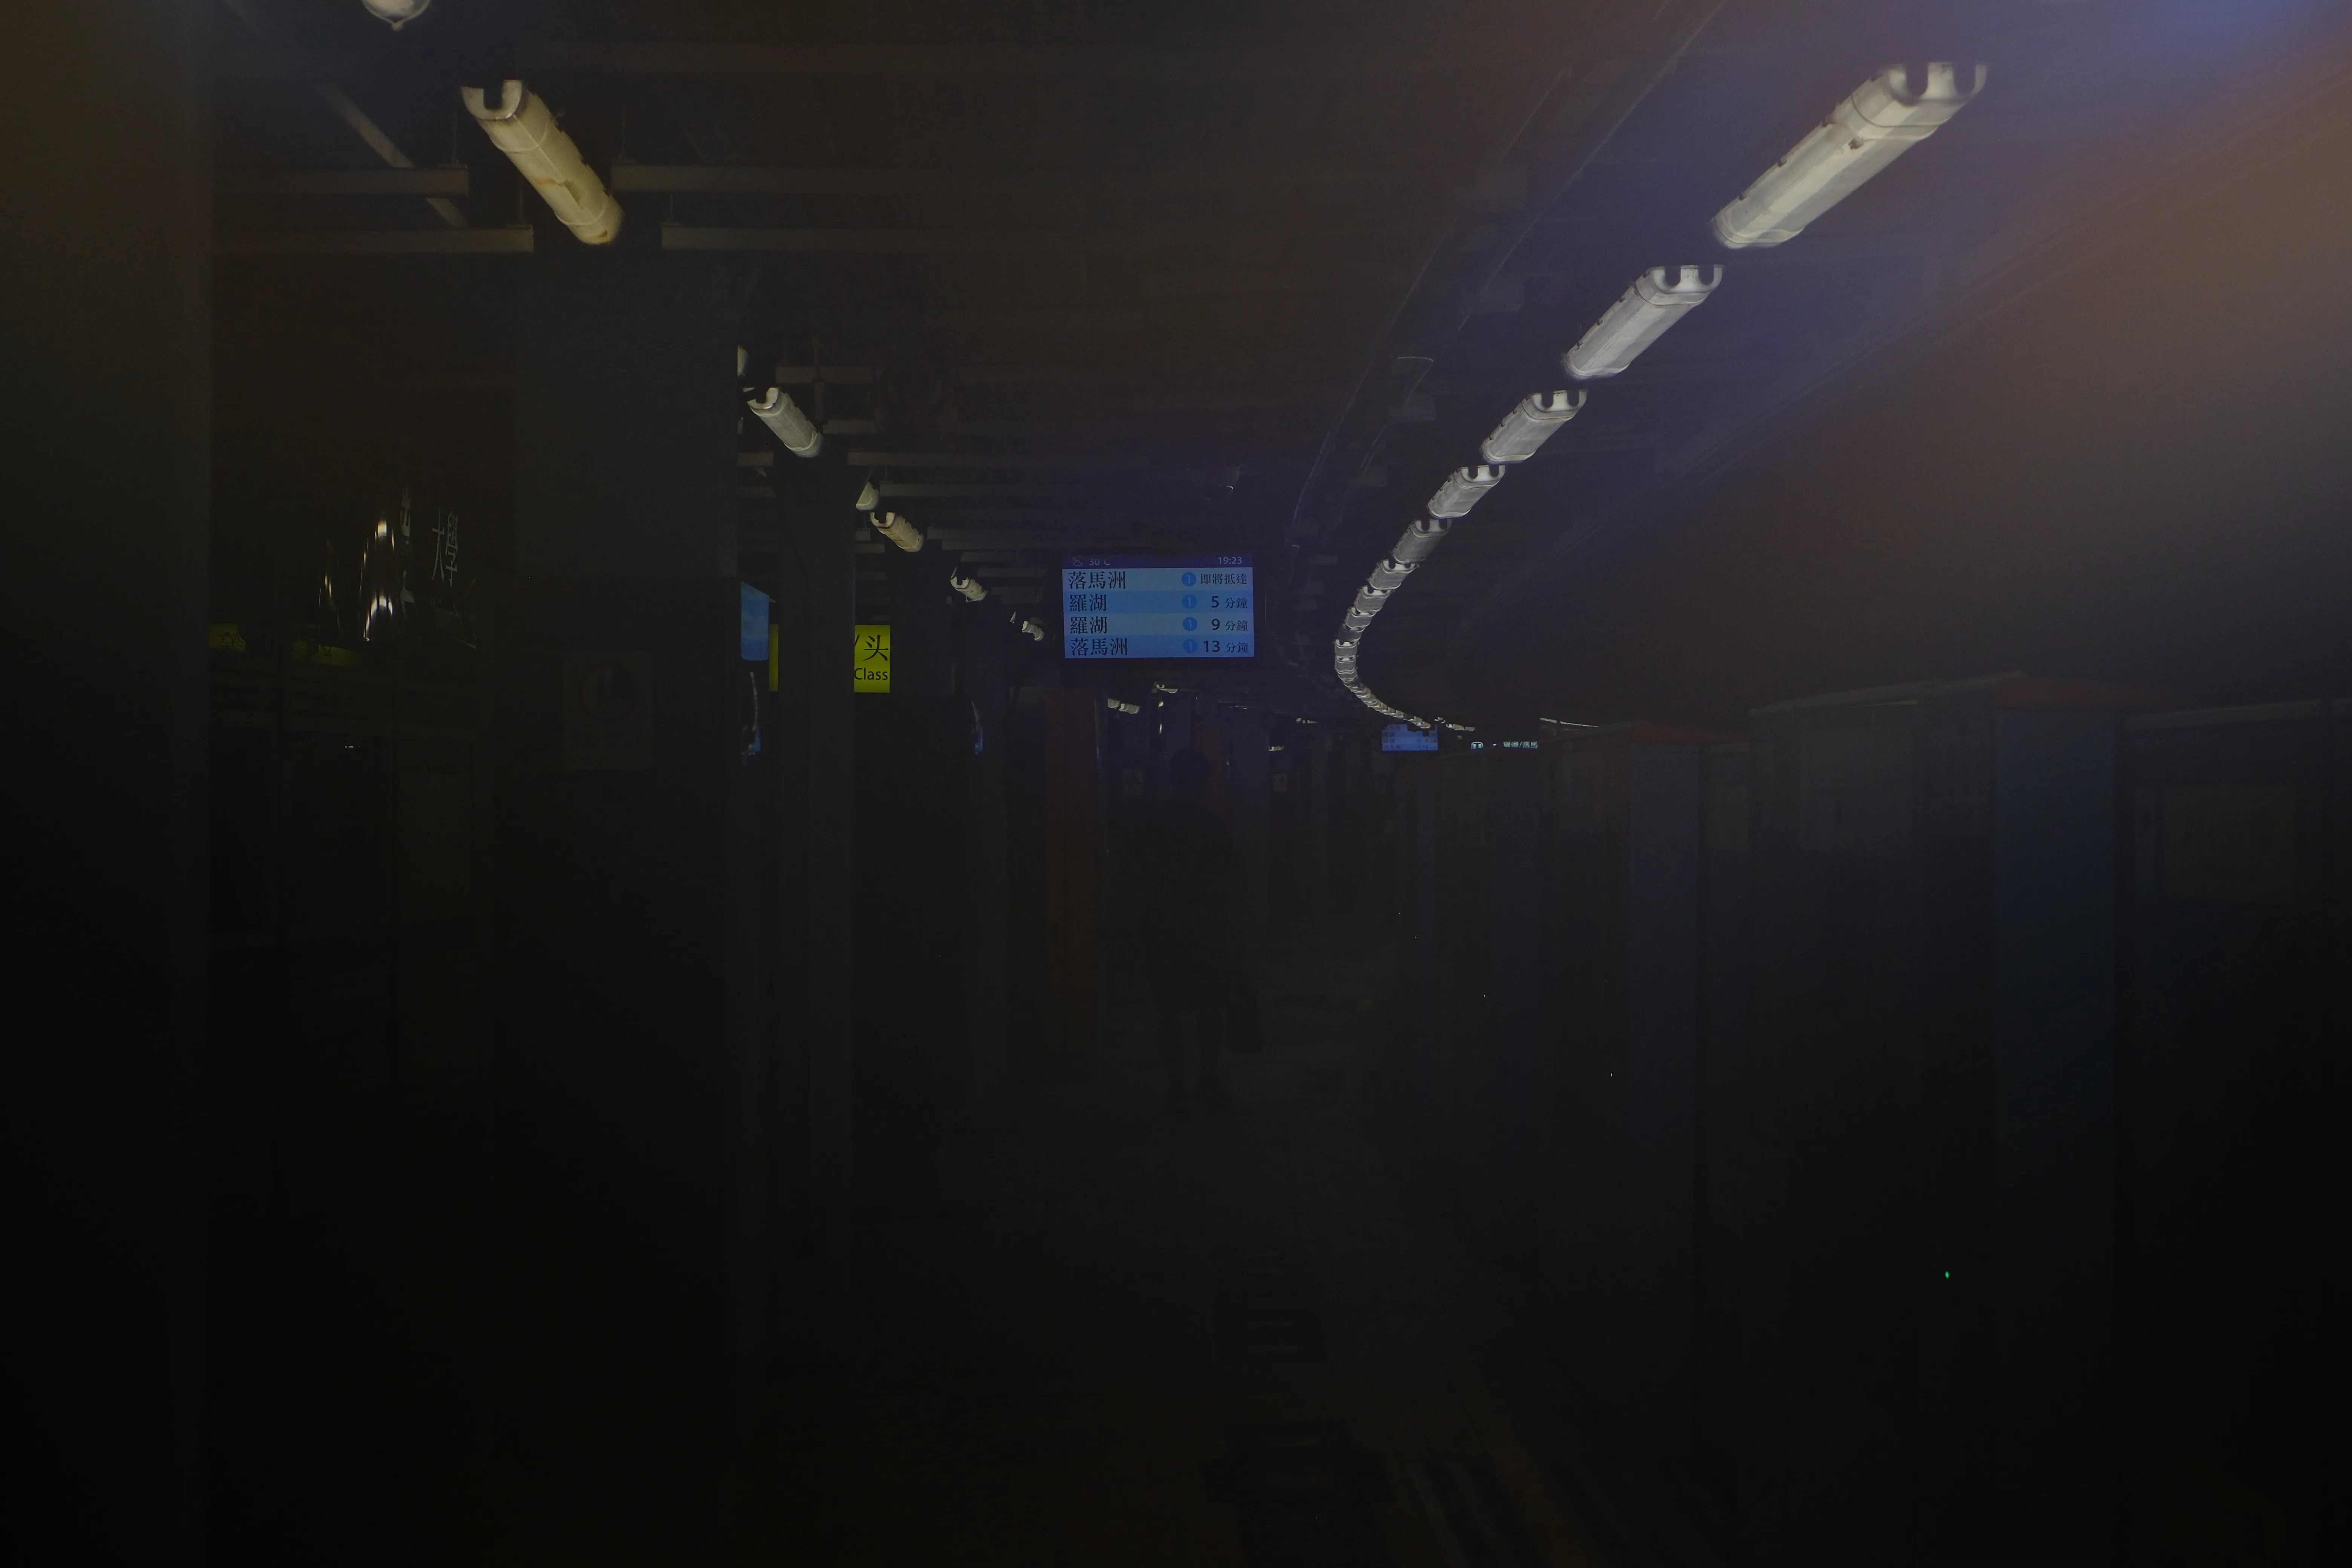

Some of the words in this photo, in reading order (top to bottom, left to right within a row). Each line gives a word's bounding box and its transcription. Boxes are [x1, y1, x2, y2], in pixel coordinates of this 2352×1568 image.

[1068, 571, 1126, 589] 落馬洲
[1200, 573, 1247, 585] 即將抵達
[1069, 594, 1107, 612] 羅湖
[1211, 596, 1219, 608] 5
[1225, 597, 1248, 608] 分鐘
[1070, 617, 1107, 634] 羅湖
[1211, 619, 1220, 630] 9
[1225, 620, 1248, 631] 分鐘
[1070, 638, 1128, 655] 落馬洲
[1204, 640, 1220, 652] 13
[1226, 643, 1248, 654] 分鐘
[854, 668, 888, 680] Class
